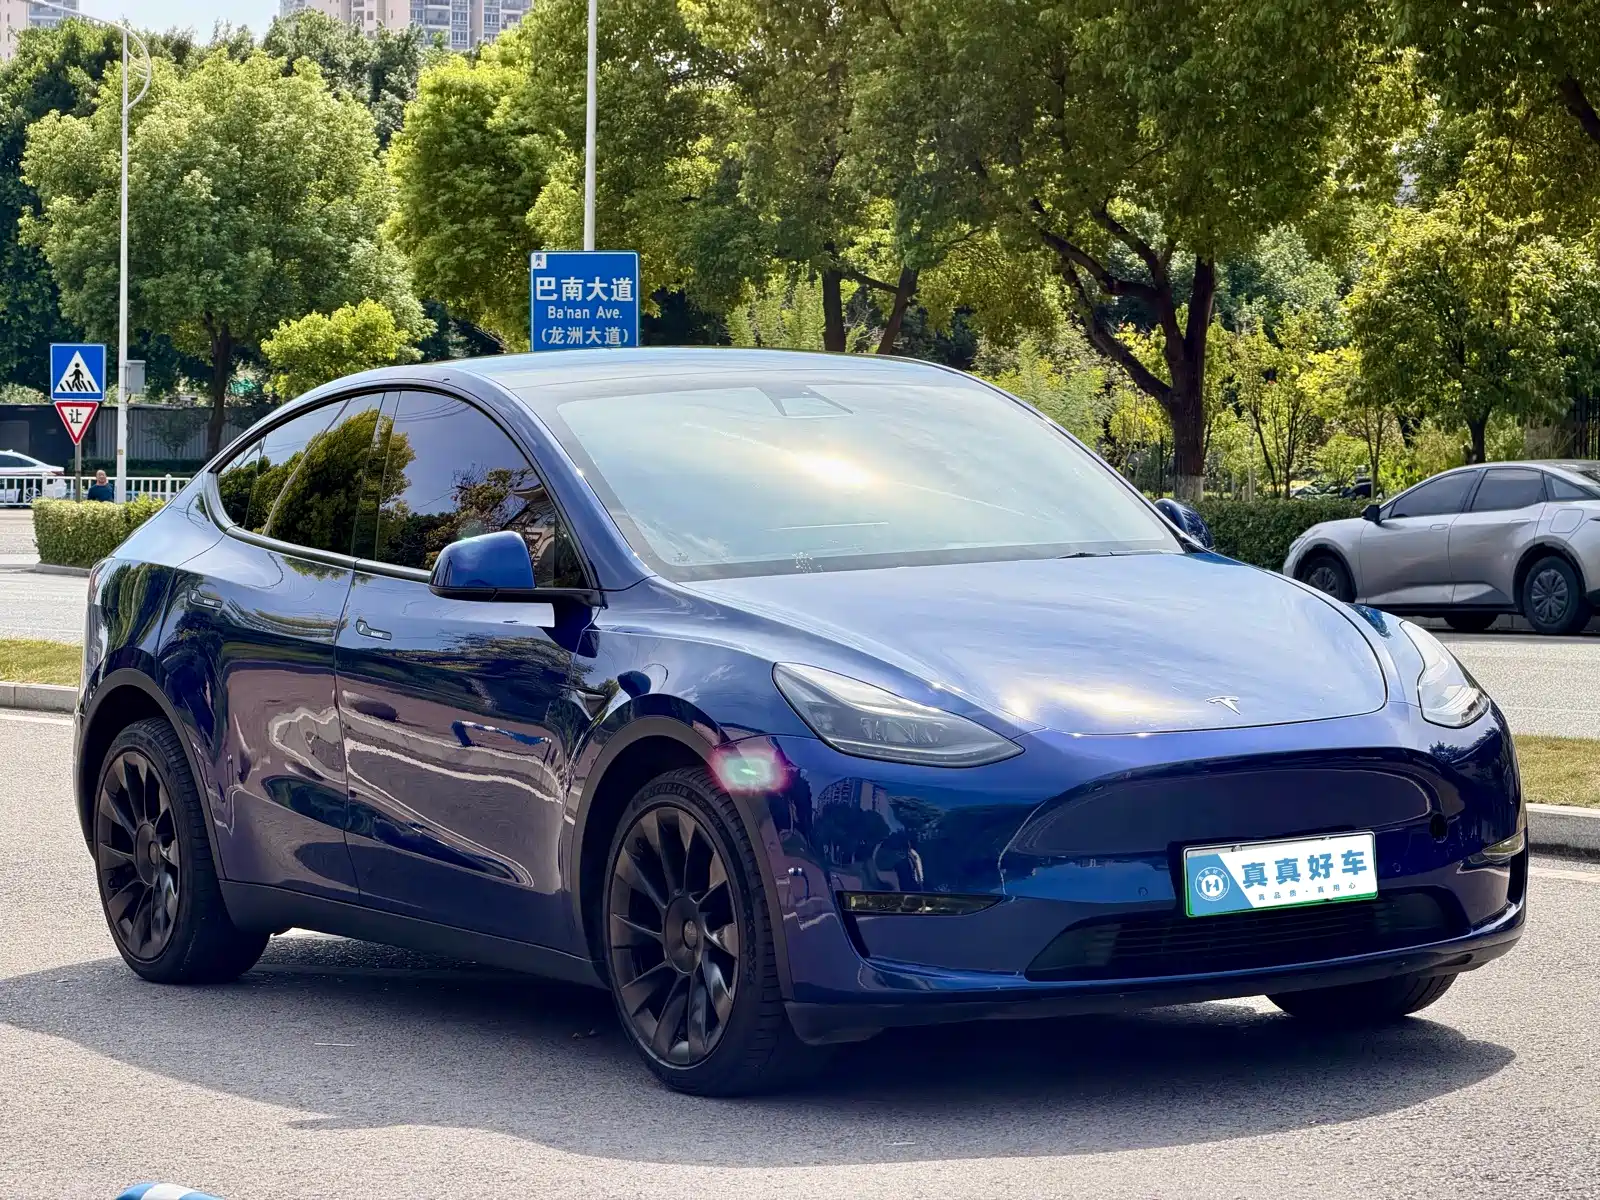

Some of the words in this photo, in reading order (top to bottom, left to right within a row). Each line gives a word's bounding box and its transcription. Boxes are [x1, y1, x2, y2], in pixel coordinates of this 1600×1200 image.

[535, 276, 634, 302] 巴南大道
[547, 305, 590, 319] Ba'nan
[596, 305, 622, 319] Ave.
[541, 326, 629, 345] (龙洲大道)
[69, 409, 82, 424] 让
[1241, 849, 1367, 889] 真真好车
